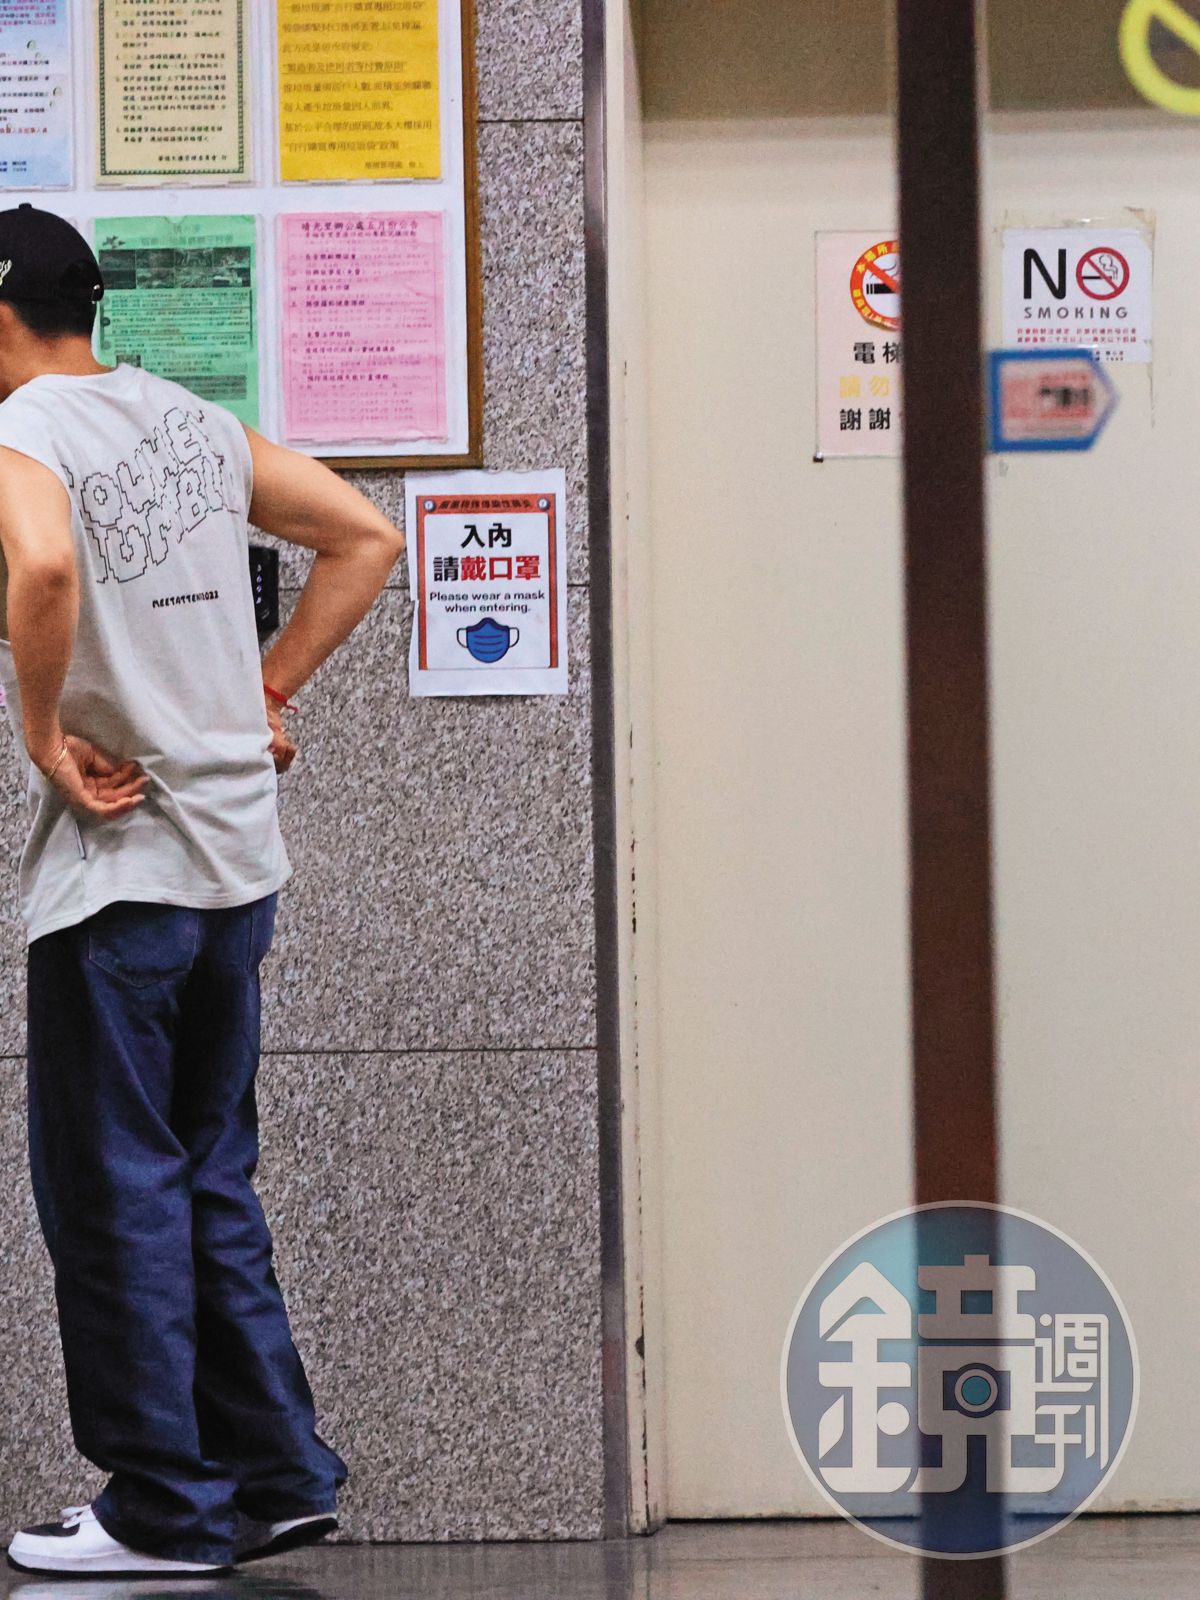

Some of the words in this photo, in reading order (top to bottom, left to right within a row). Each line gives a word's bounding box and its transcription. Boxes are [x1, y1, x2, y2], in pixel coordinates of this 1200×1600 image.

[1023, 306, 1129, 319] SMOKING
[839, 408, 891, 431] 謝謝
[460, 522, 512, 549] 入內
[433, 555, 541, 582] 請戴口罩
[430, 592, 469, 601] Please
[471, 593, 502, 601] wear
[514, 590, 545, 600] mask
[445, 604, 477, 613] when
[479, 603, 531, 614] entering.
